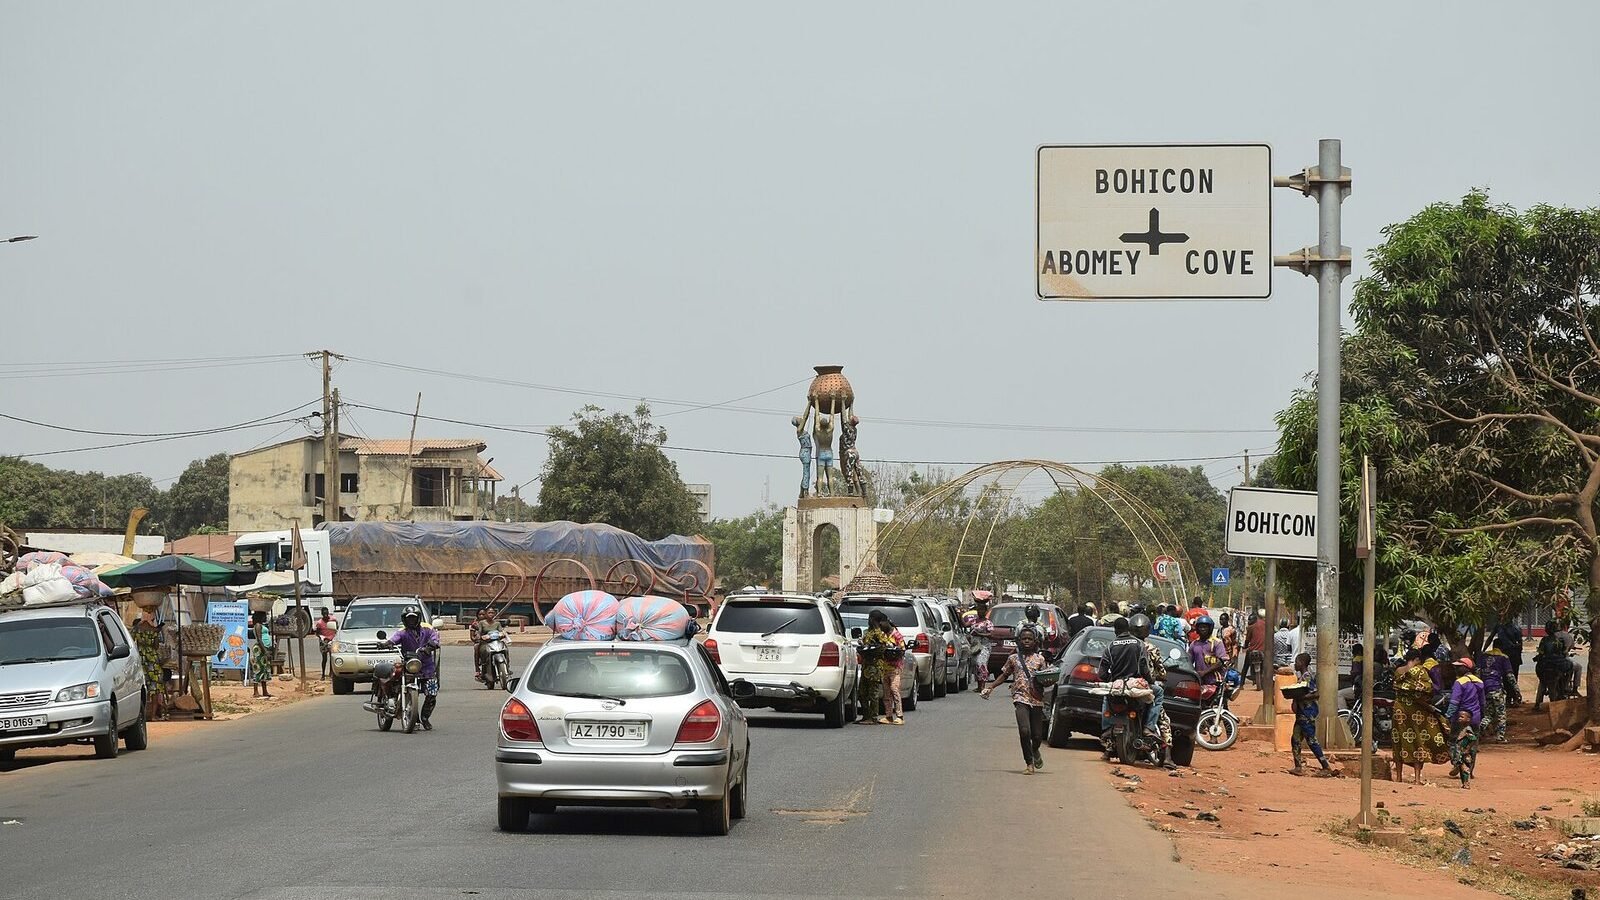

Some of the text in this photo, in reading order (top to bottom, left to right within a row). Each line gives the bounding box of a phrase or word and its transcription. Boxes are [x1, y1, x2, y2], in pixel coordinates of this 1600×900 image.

[1095, 168, 1213, 194] BOHICON
[1041, 250, 1141, 275] ABOMEY
[1185, 250, 1254, 275] COVE
[1234, 510, 1316, 537] BOHICON
[12, 718, 33, 727] 0169
[574, 725, 593, 737] AZ
[596, 725, 625, 738] 1790
